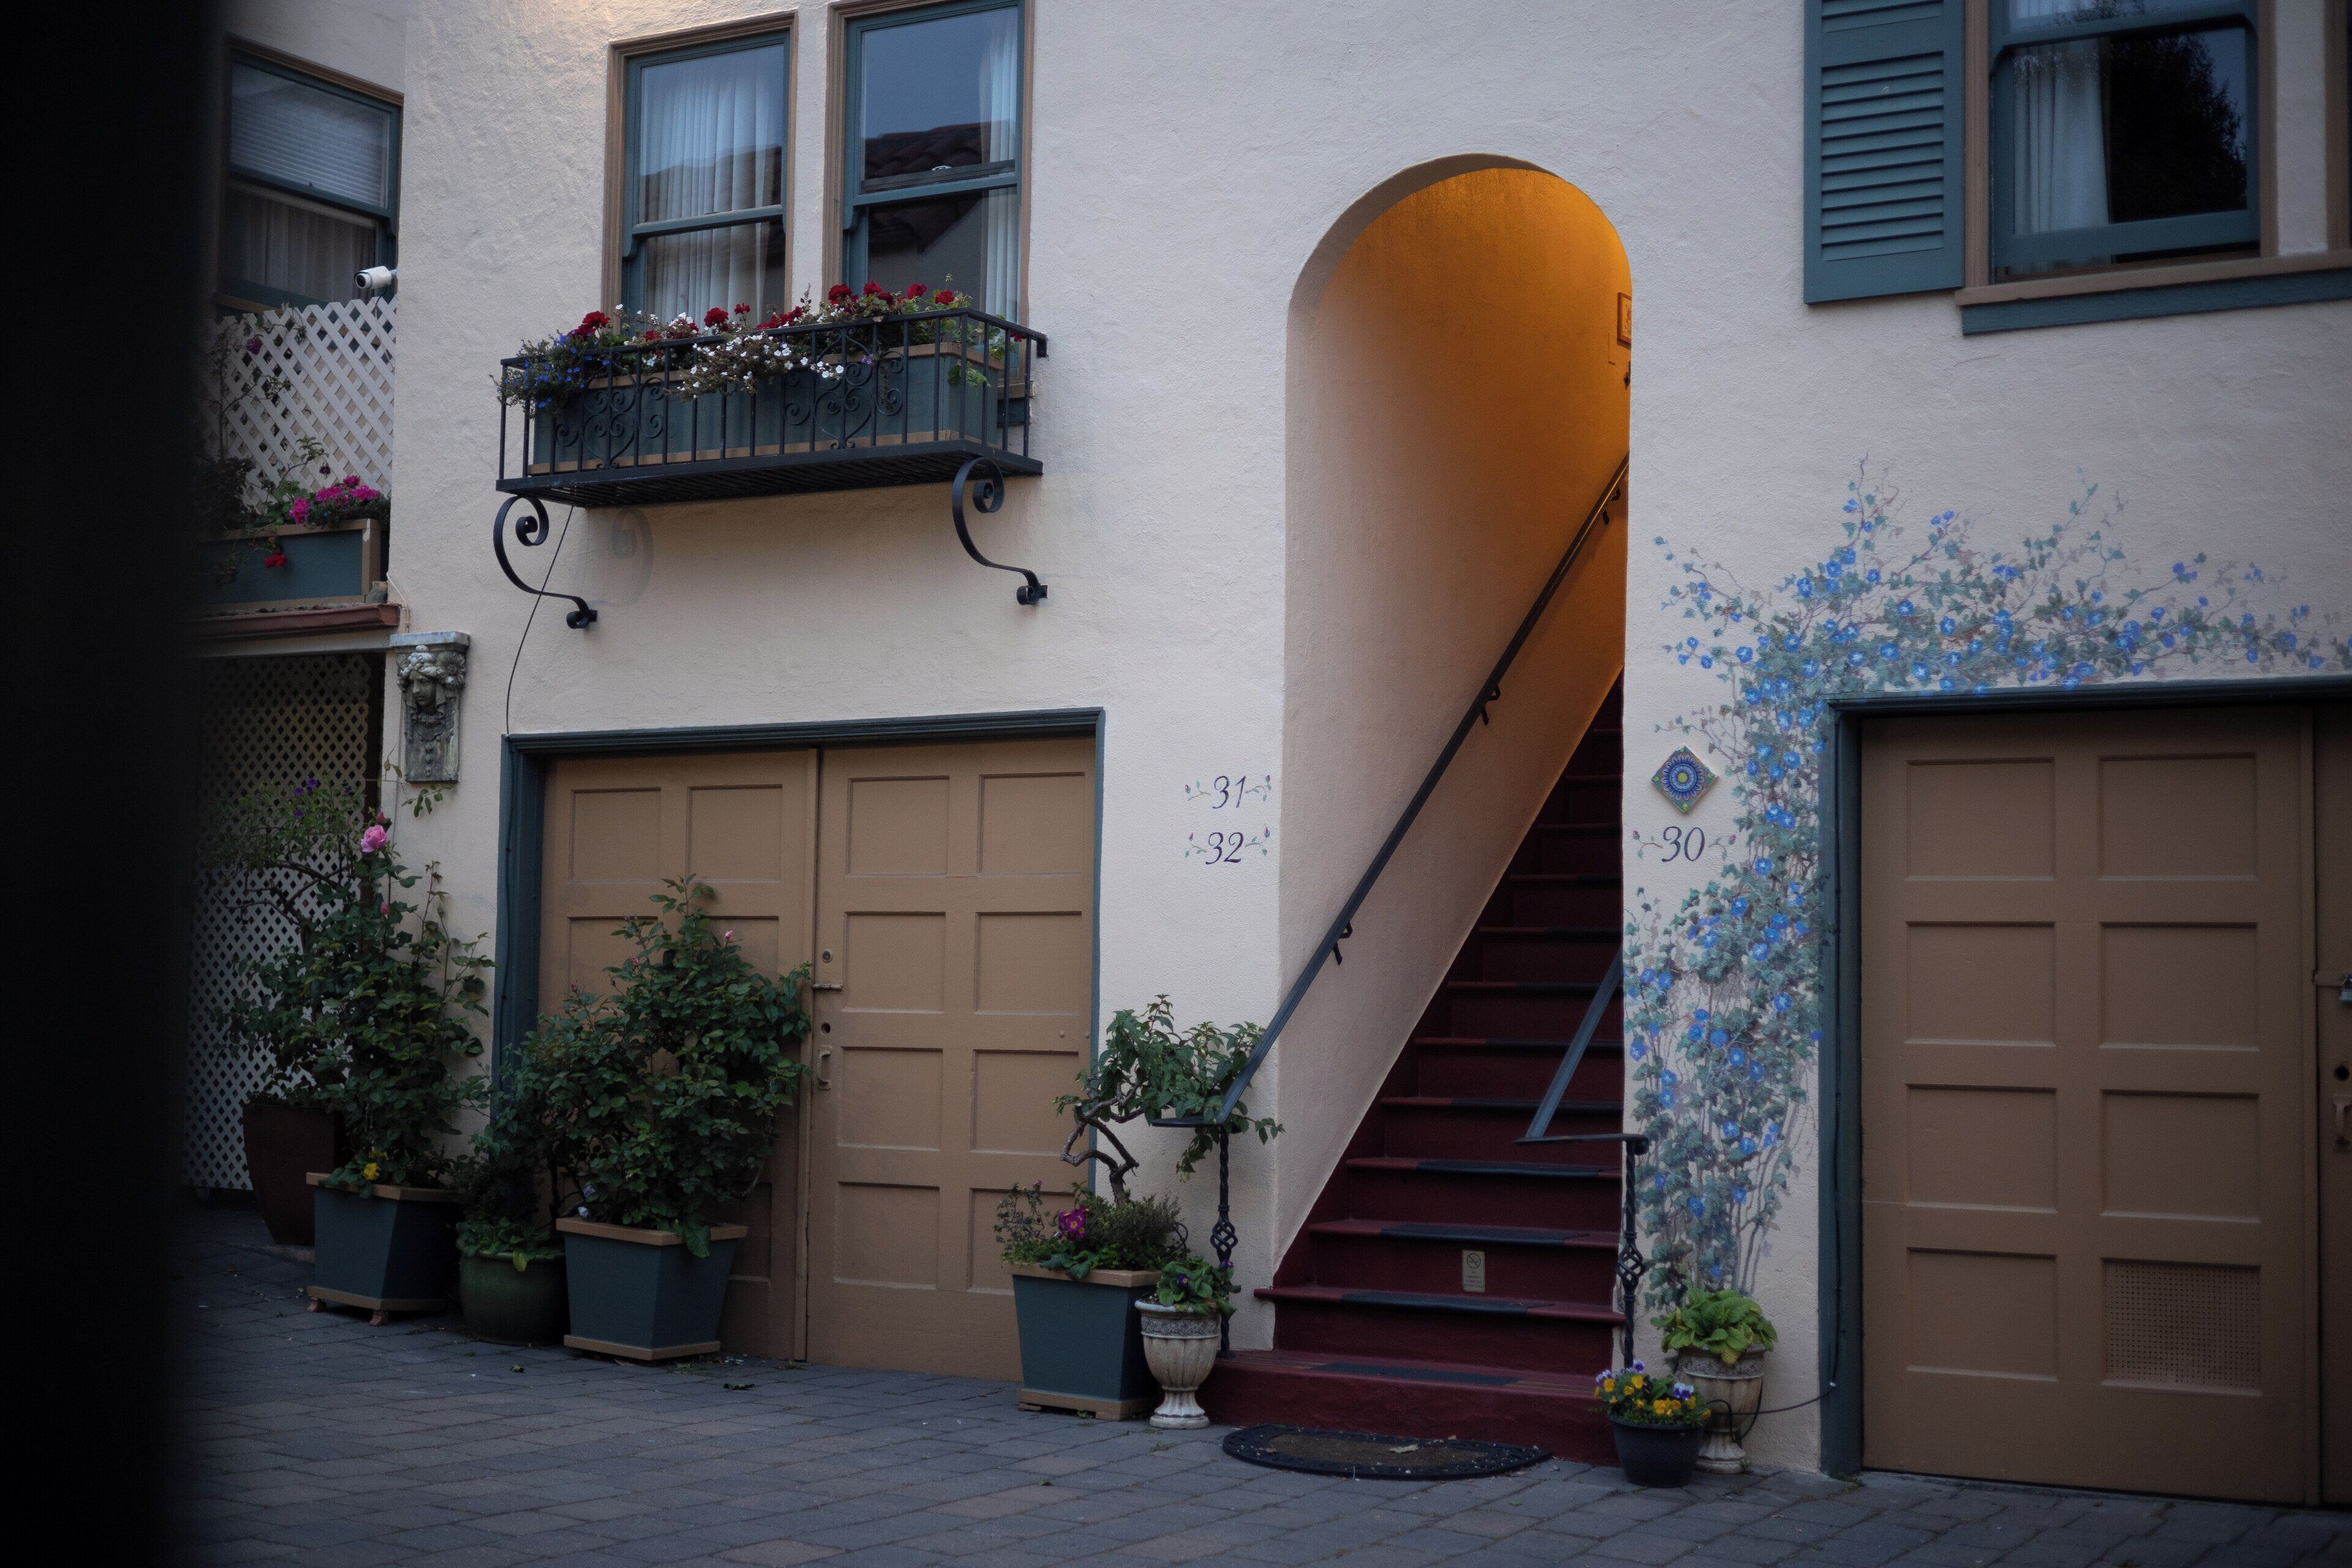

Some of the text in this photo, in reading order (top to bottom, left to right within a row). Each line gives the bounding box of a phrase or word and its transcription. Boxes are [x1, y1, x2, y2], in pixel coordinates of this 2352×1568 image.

[1212, 775, 1246, 809] 31
[1205, 832, 1244, 865] 32
[1661, 826, 1705, 862] 30
